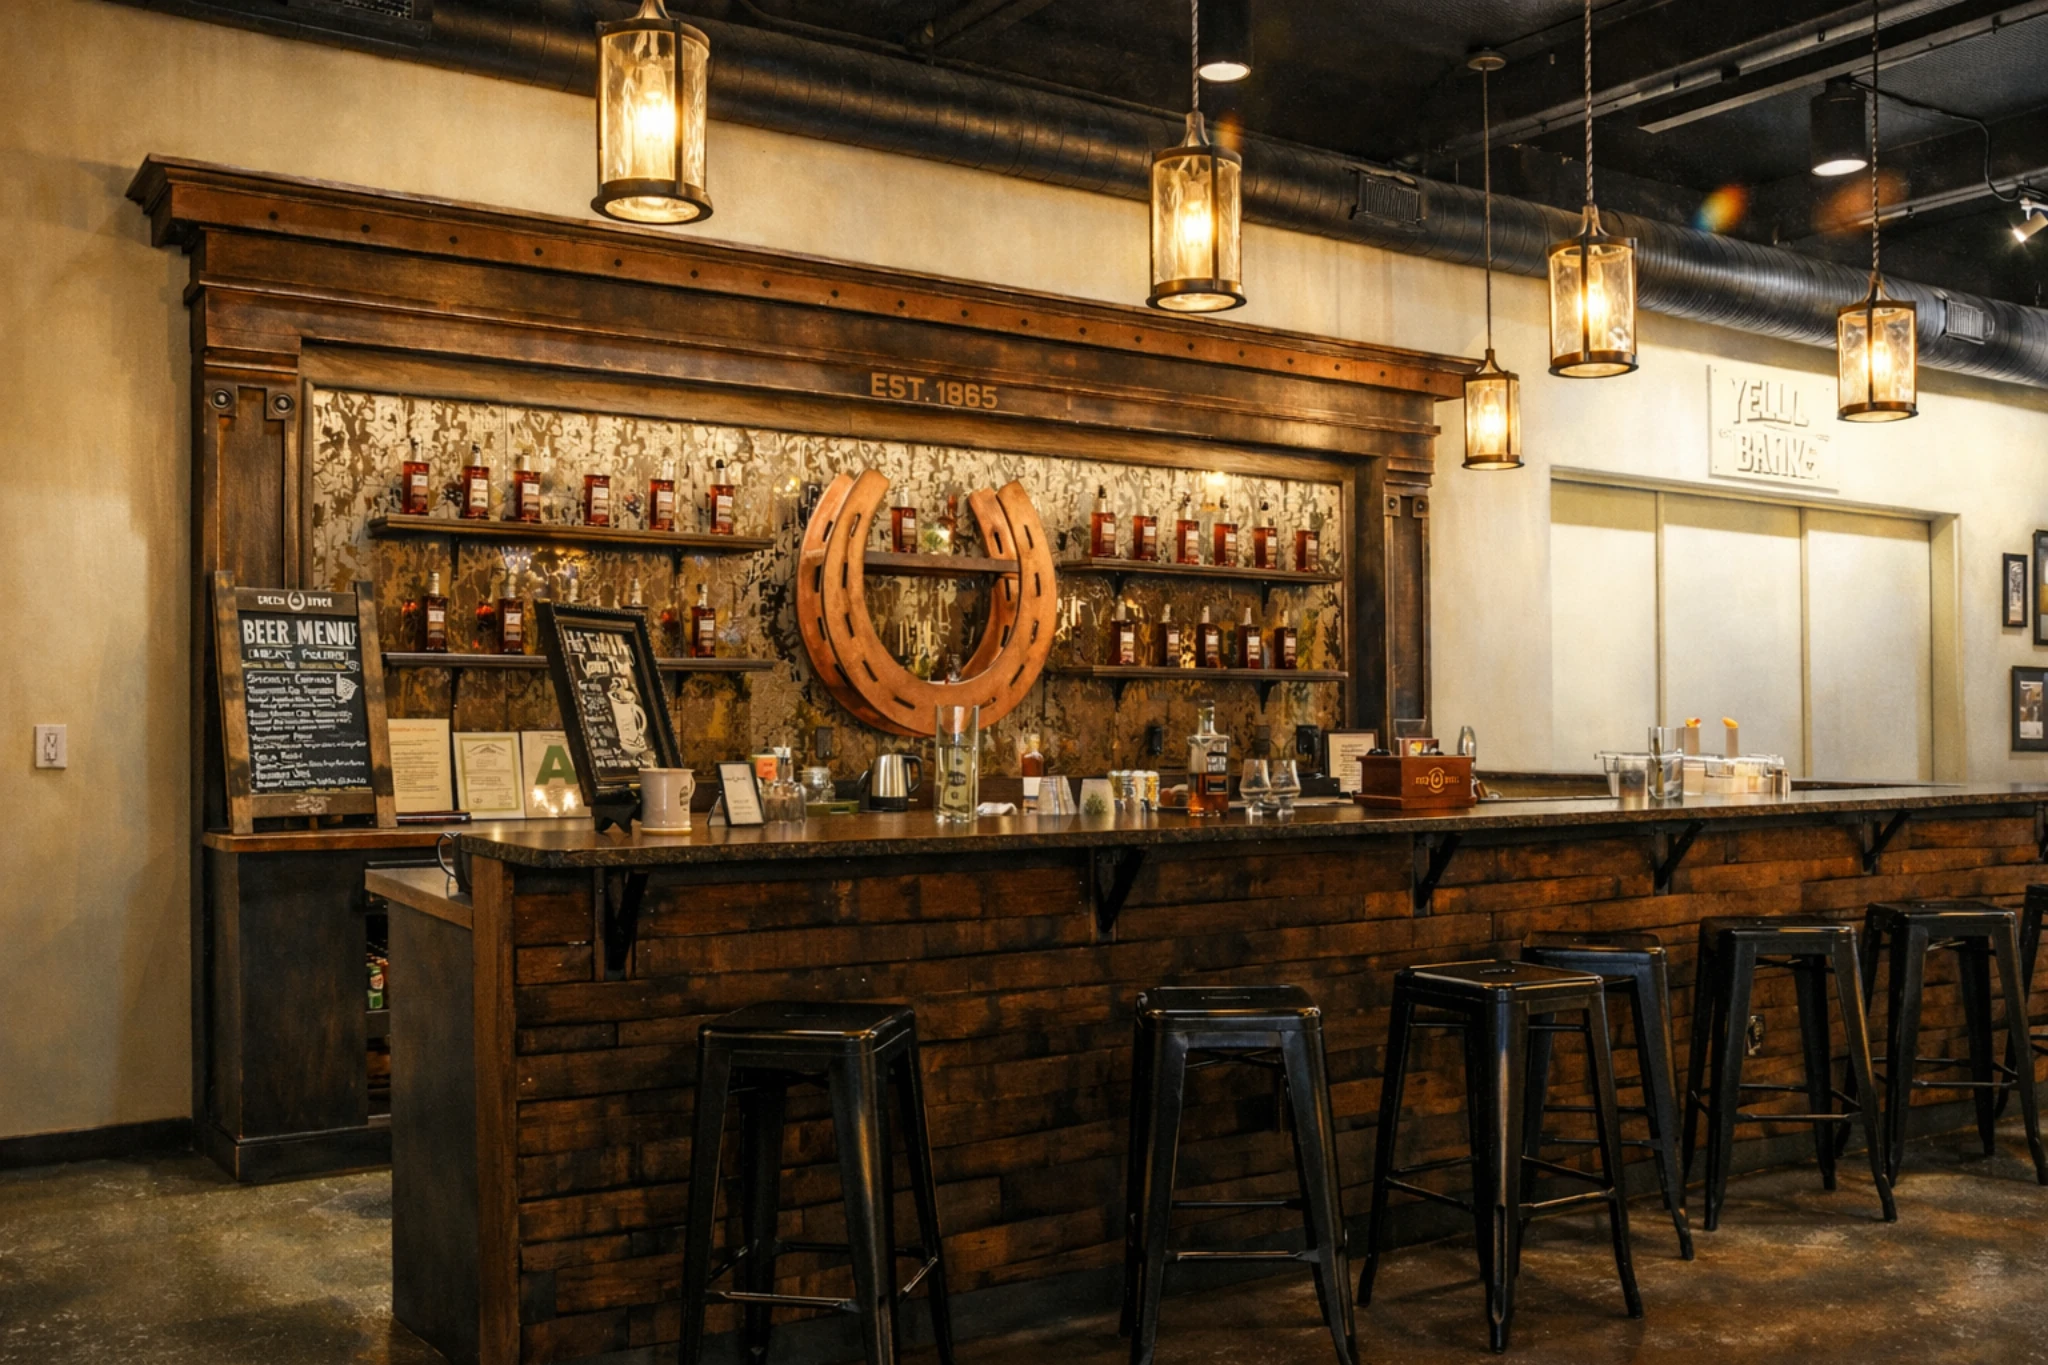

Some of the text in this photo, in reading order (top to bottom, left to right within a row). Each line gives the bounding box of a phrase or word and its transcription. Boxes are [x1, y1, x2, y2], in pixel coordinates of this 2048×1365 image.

[871, 372, 998, 409] EST. 1865
[242, 619, 357, 646] BEER MENU
[535, 745, 578, 785] A
